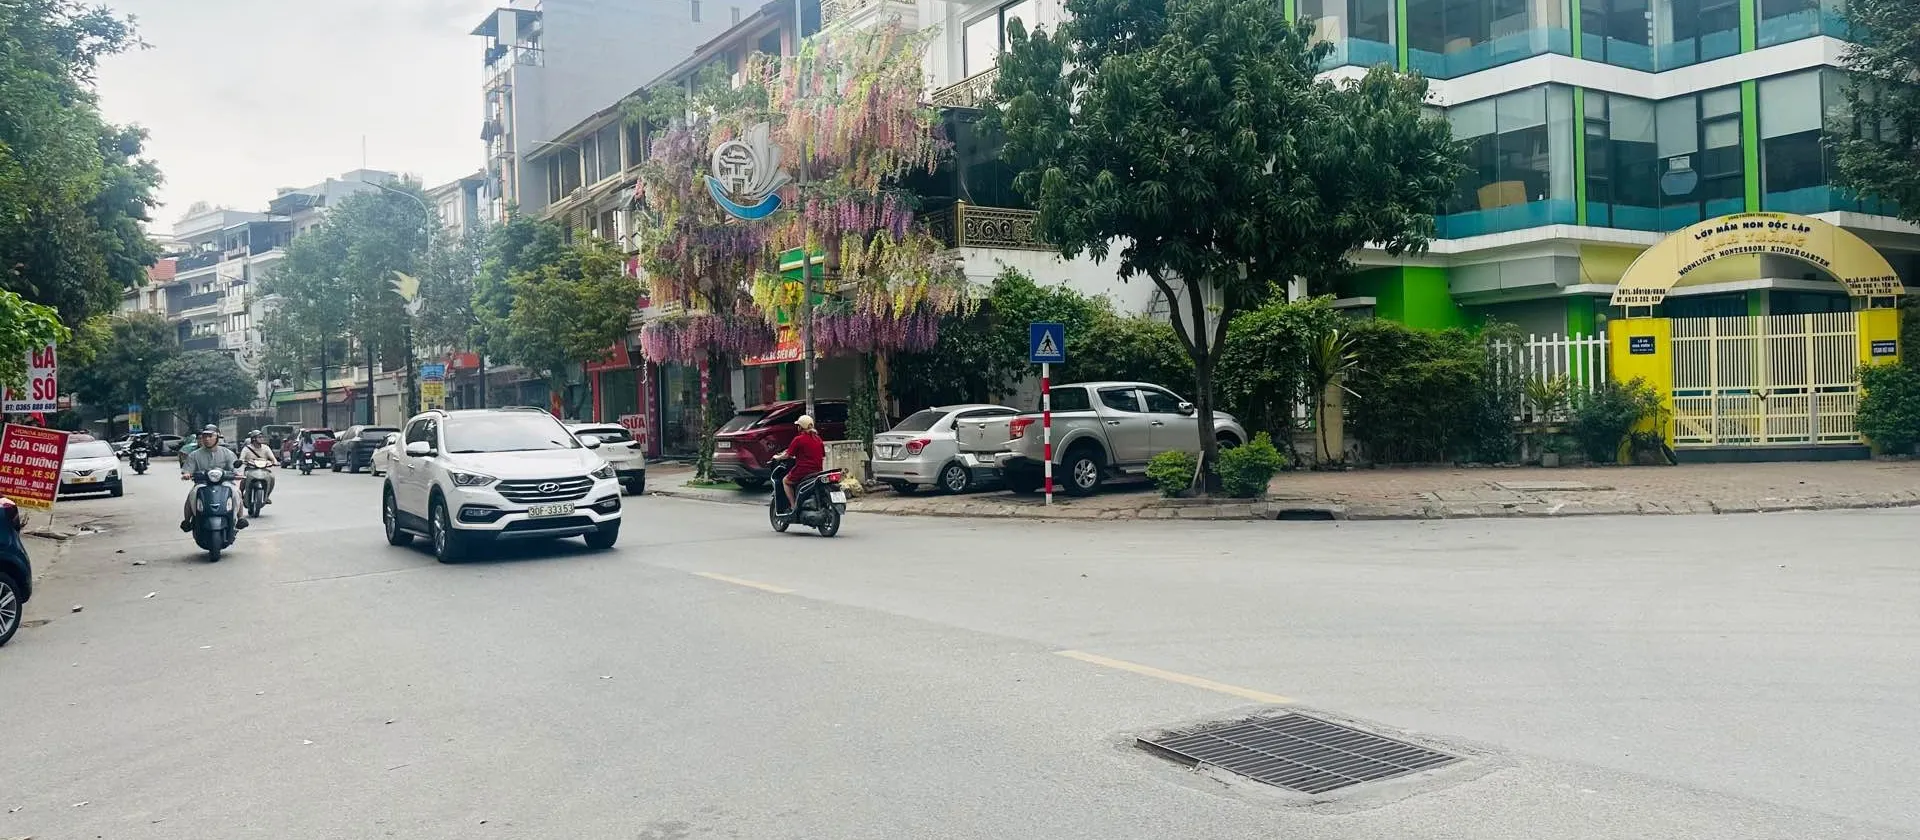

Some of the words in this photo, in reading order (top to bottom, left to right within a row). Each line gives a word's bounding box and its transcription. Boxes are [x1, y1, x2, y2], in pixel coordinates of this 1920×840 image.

[1743, 221, 1764, 229] NON
[1678, 254, 1716, 276] MOONLIGHT
[1719, 245, 1766, 257] MONTESSORI
[1770, 245, 1830, 267] KINDERGARTEN
[32, 346, 56, 368] GA
[33, 369, 56, 400] SỐ
[10, 437, 30, 450] SỬA
[32, 442, 58, 455] CHỮA
[3, 452, 23, 464] BẢO
[25, 456, 59, 469] DƯỠNG
[1, 465, 12, 473] XE
[13, 467, 25, 475] GA
[32, 470, 43, 479] XE
[44, 470, 56, 480] SỐ
[45, 482, 54, 491] XE
